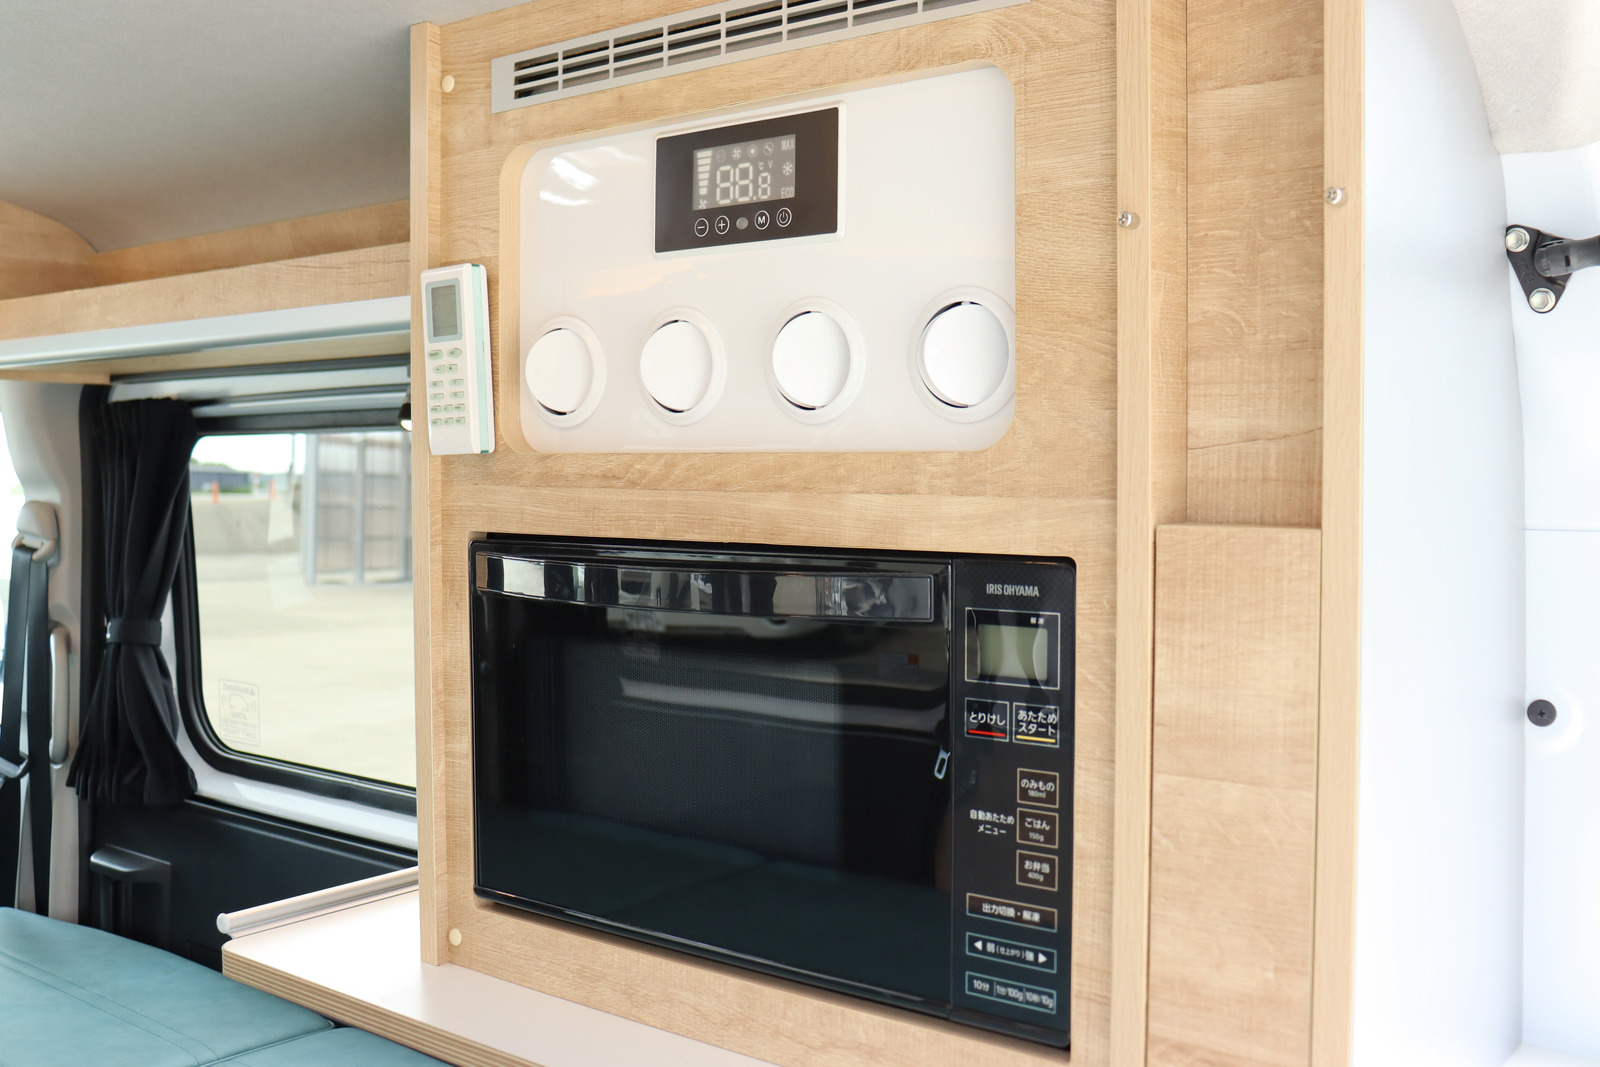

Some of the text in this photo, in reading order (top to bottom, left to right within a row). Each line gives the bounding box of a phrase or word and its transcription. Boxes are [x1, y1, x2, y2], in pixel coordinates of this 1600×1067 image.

[781, 139, 794, 151] MAX
[781, 187, 794, 198] ECO
[757, 215, 766, 225] M
[986, 583, 1039, 597] IRIS OHYAMA
[969, 711, 1006, 726] とりけし
[1017, 709, 1058, 724] あたため
[1018, 722, 1056, 736] スタート
[1020, 778, 1055, 792] のみもの
[969, 809, 1015, 825] 自動あたため
[1024, 817, 1051, 831] ごはん
[977, 824, 1007, 835] メニュー
[1024, 860, 1050, 874] お弁当
